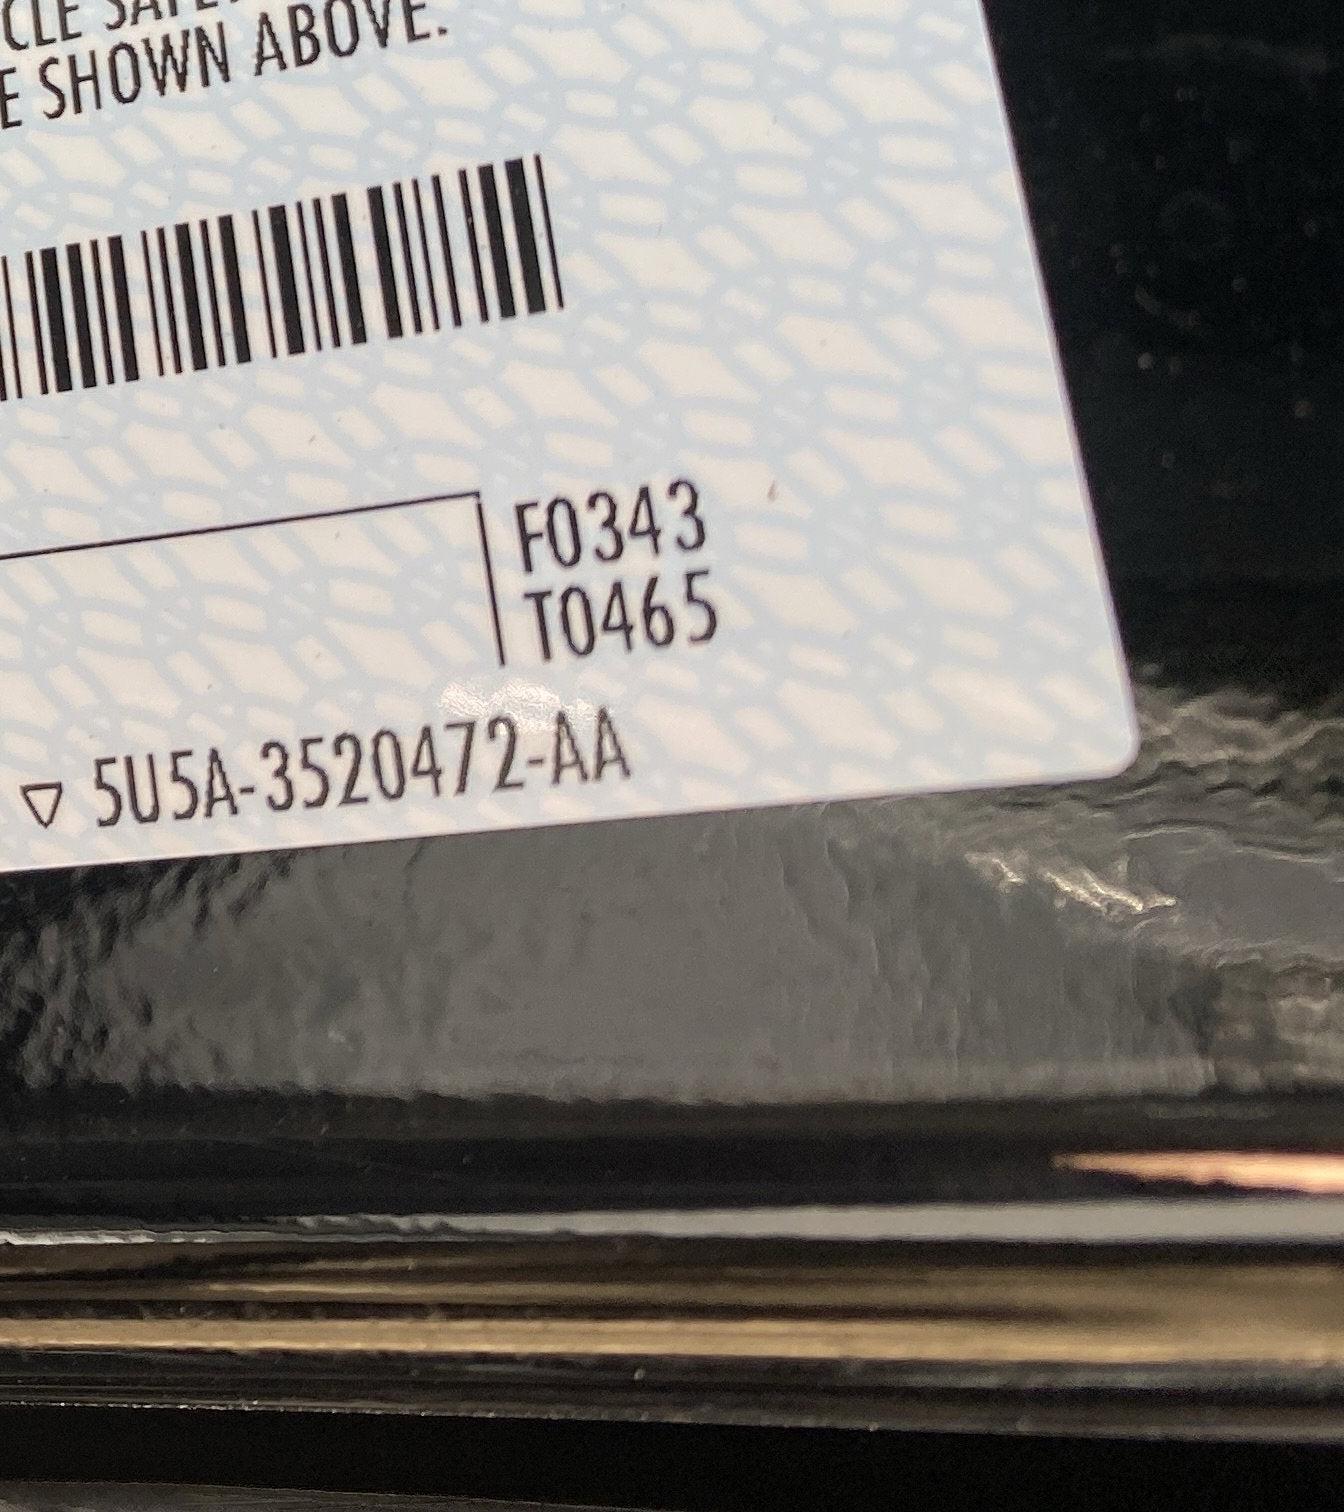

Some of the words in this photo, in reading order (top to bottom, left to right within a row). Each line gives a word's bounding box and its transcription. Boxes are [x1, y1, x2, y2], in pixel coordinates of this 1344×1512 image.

[39, 23, 229, 119] SHOWN
[517, 479, 708, 573] F0343
[524, 569, 717, 662] T0465
[93, 707, 632, 828] 5U5A-3520472-AA
